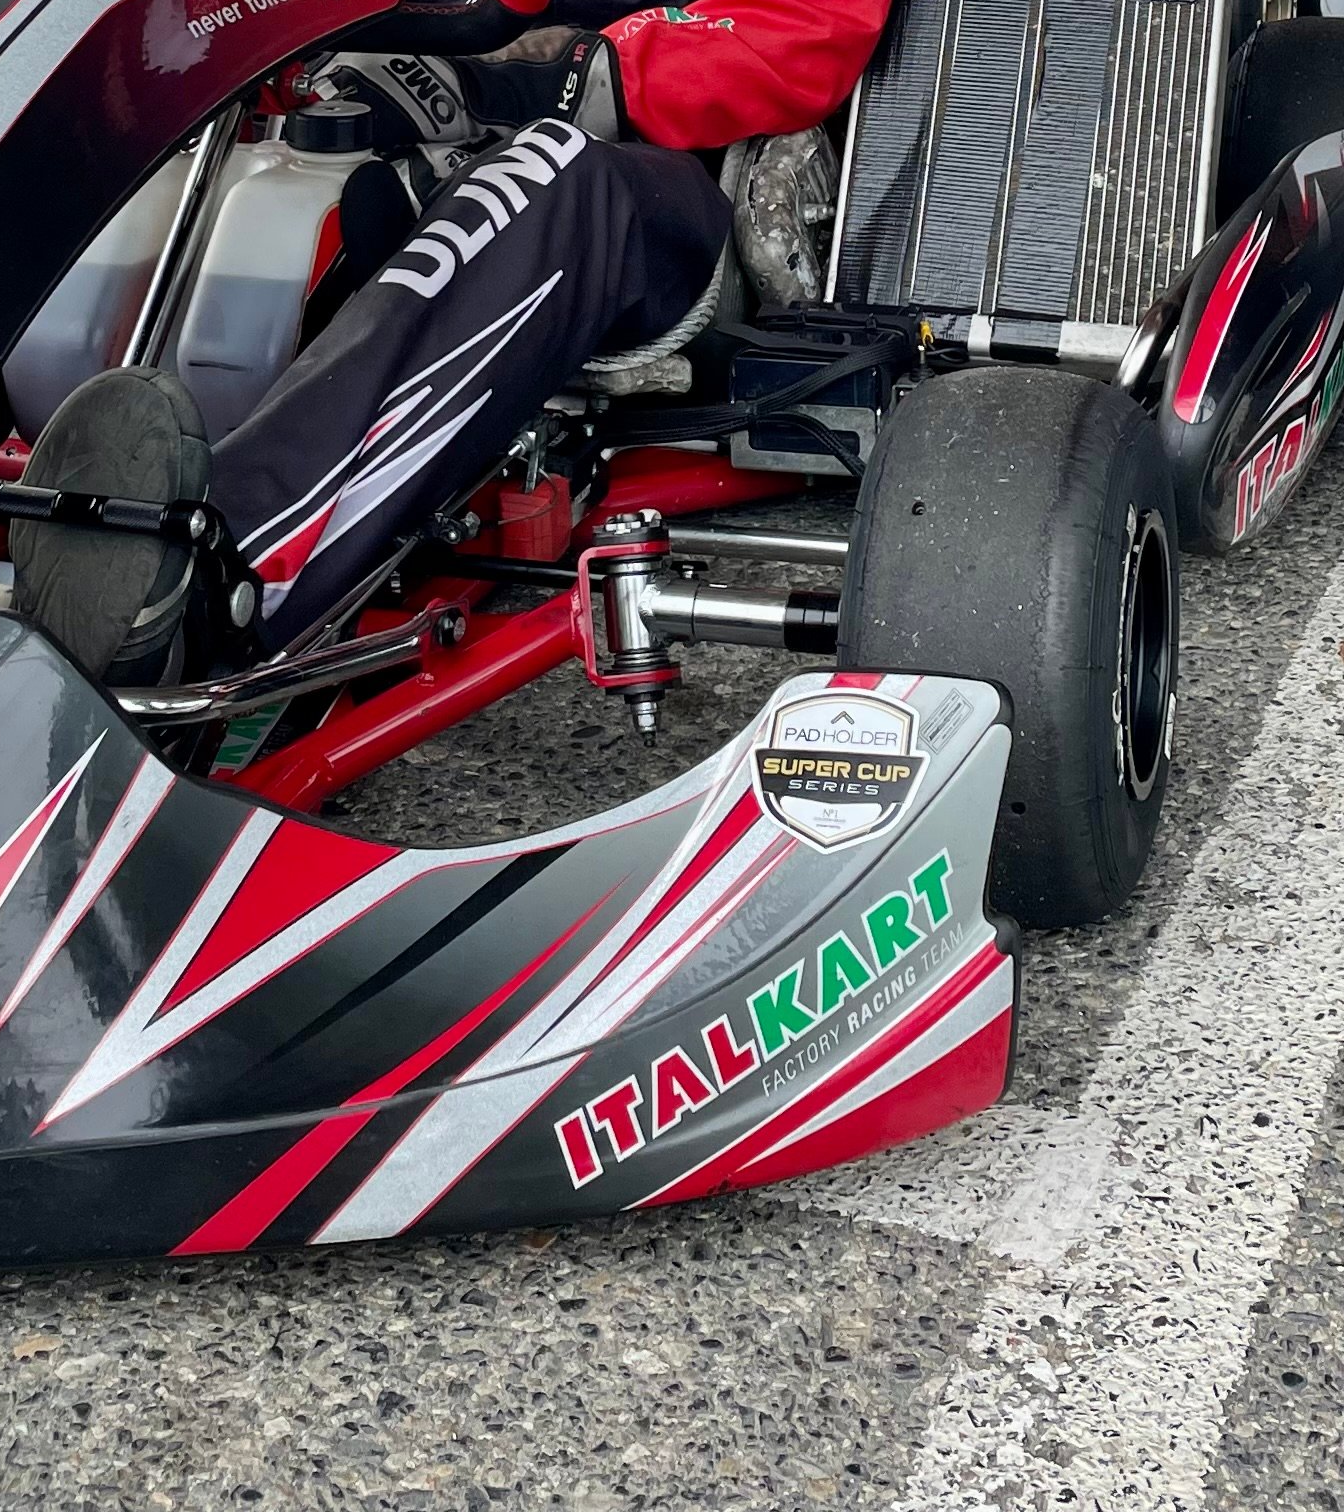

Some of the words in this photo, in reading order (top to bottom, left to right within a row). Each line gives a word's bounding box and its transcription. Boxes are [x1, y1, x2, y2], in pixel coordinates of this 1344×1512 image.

[187, 2, 243, 38] never
[389, 58, 456, 125] OMP
[378, 117, 587, 299] ULIND
[762, 757, 851, 779] SUPER
[857, 762, 911, 783] CUP
[787, 779, 880, 796] SERIES
[554, 847, 955, 1190] ITALKART
[761, 1024, 841, 1098] FACTORY
[847, 965, 918, 1035] RACING
[921, 922, 965, 973] TEAM
